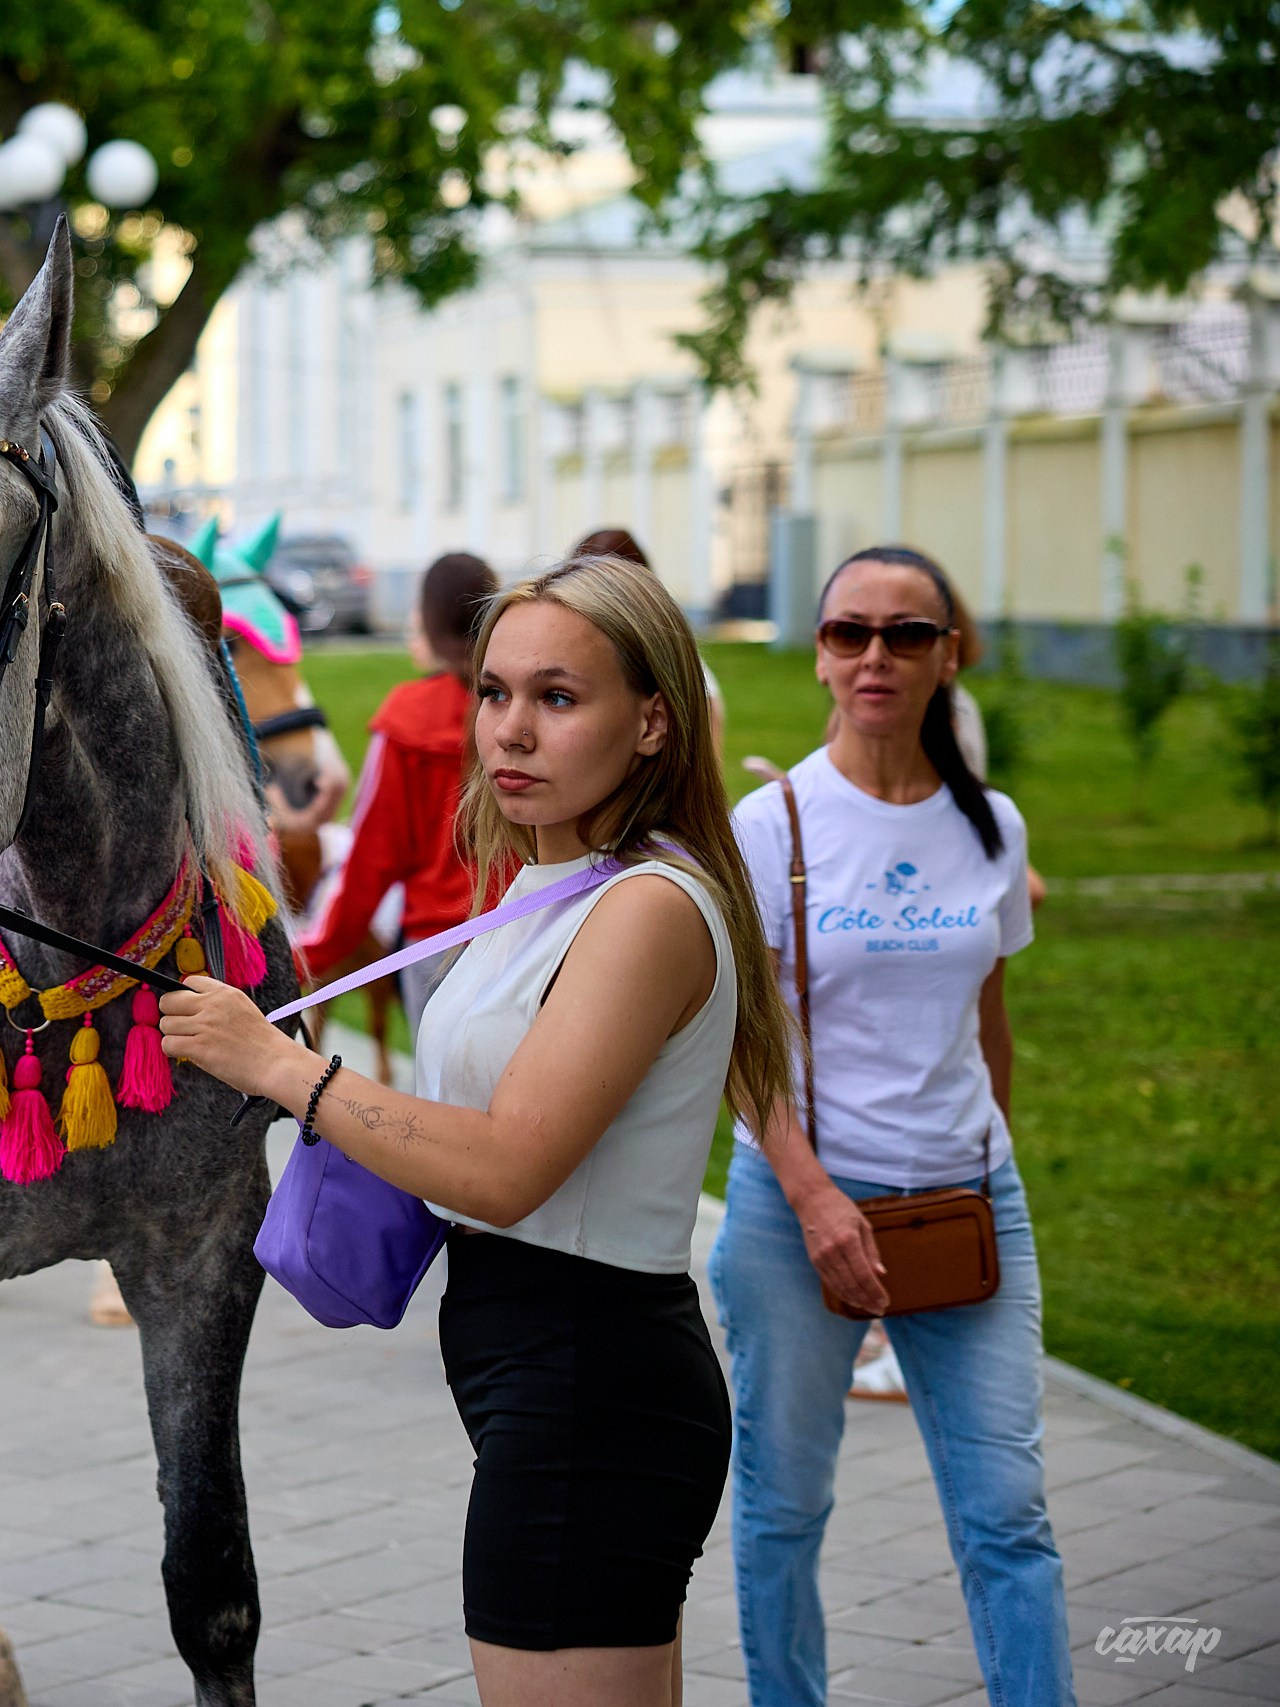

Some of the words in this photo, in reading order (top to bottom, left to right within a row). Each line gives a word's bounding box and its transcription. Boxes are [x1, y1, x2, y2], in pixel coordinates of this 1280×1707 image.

[893, 904, 980, 932] Soleil
[866, 939, 905, 953] BEACH
[907, 938, 940, 952] CLUB
